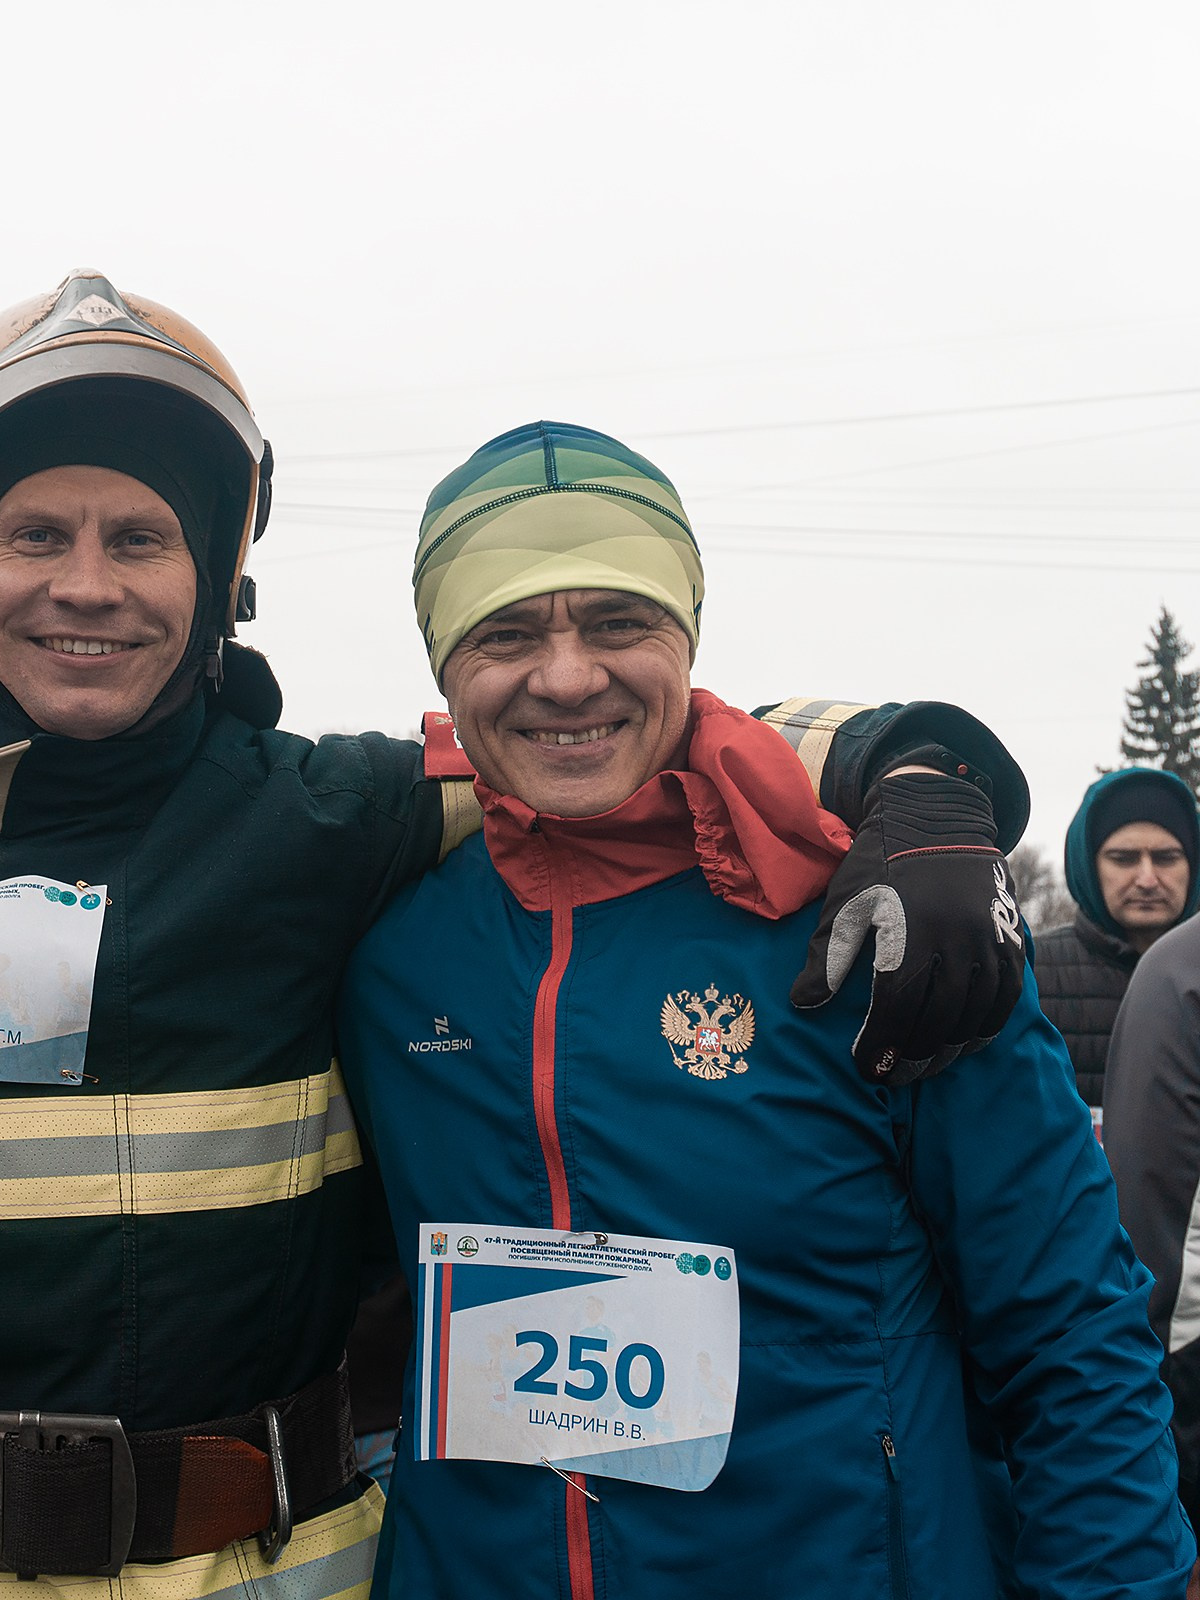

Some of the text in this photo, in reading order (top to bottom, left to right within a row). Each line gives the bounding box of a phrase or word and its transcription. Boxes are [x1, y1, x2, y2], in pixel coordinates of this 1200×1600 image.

[18, 883, 46, 891] ПРОБЕГ,
[408, 1038, 472, 1052] NORDSKI
[484, 1236, 501, 1244] 47-Й
[501, 1238, 567, 1249] ТРАДИЦИОННЫЙ
[647, 1250, 677, 1261] ПРОБЕГ,
[510, 1247, 651, 1266] ПОСВЯЩЕННЫЙ ПАМЯТИ ПОЖАРНЫХ,
[554, 1257, 594, 1265] ИСПОЛНЕНИИ
[594, 1261, 633, 1269] СЛУЖЕБНОГО
[633, 1265, 653, 1273] ДОЛГА
[513, 1330, 665, 1410] 250
[529, 1408, 647, 1441] ШАДРИН В.В.
